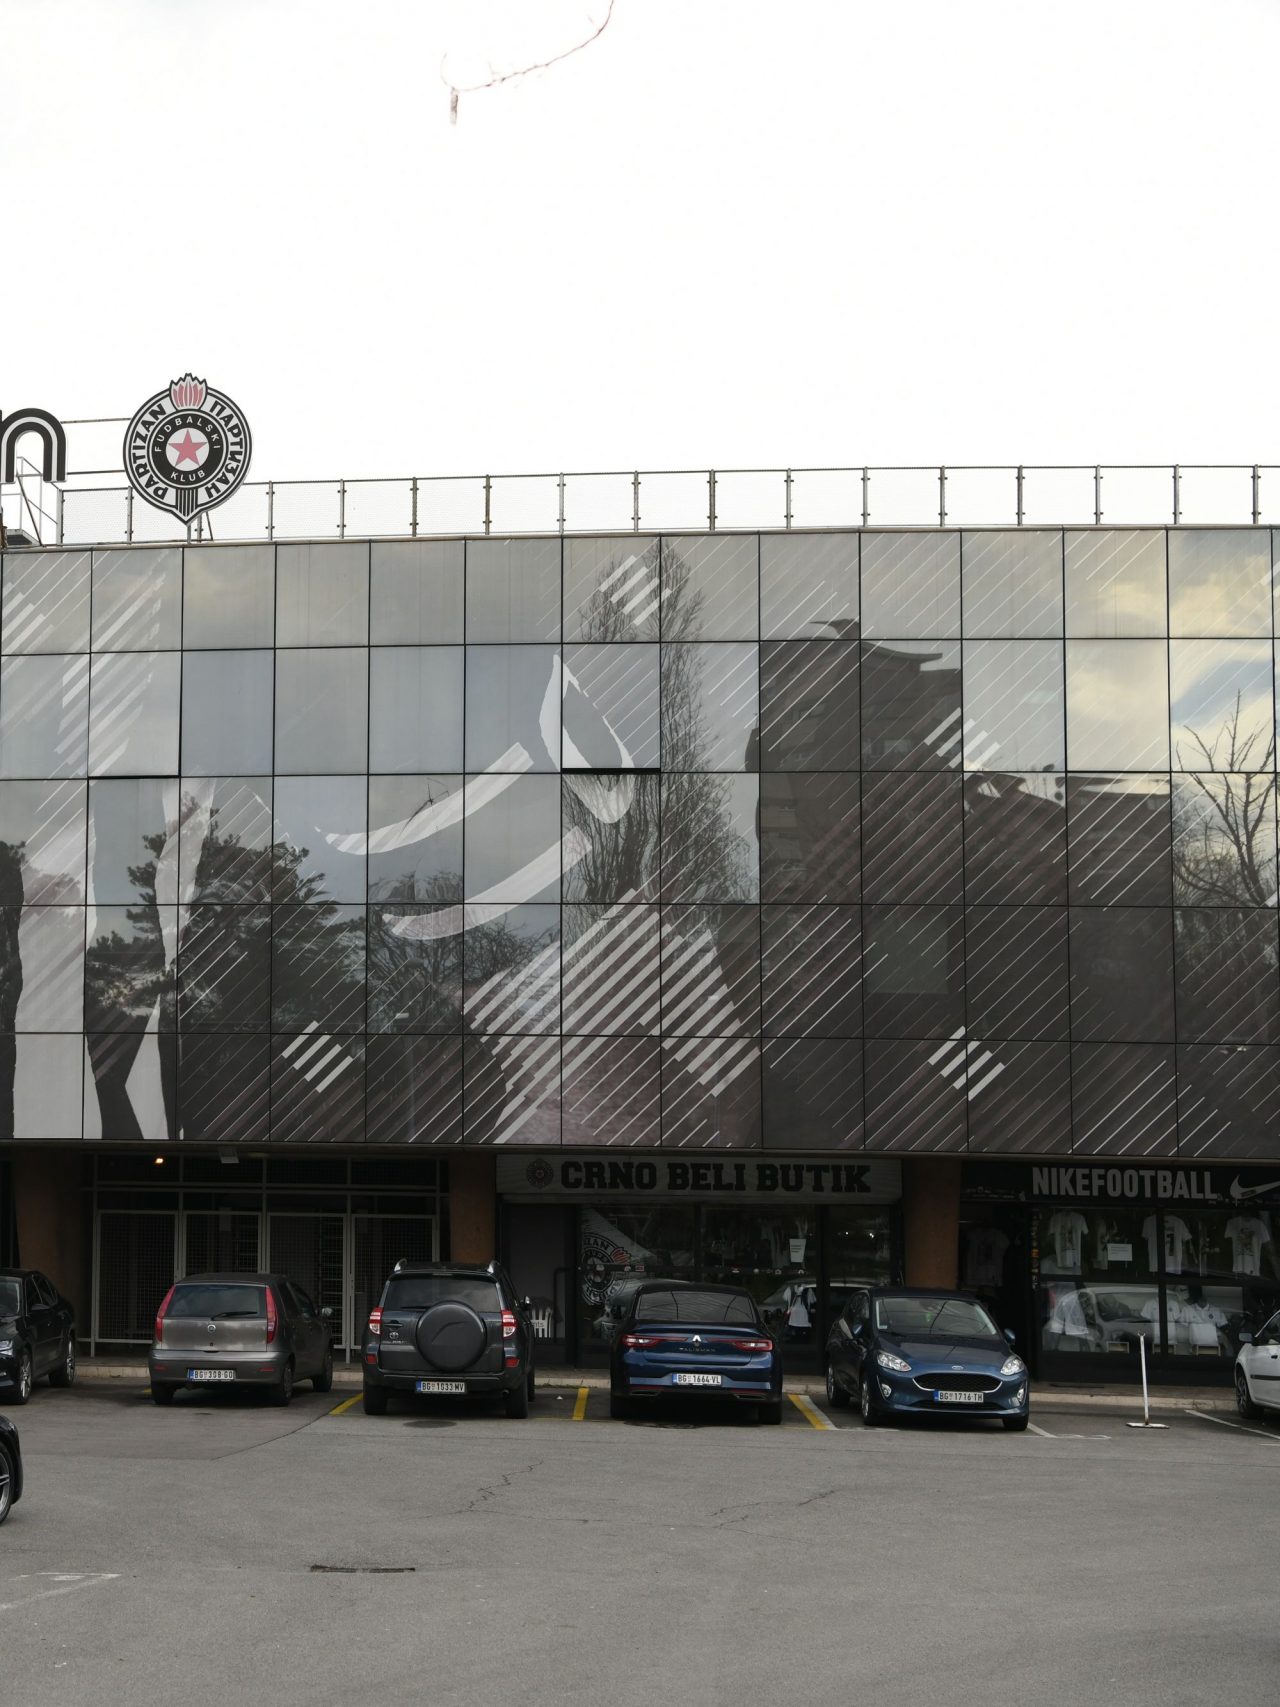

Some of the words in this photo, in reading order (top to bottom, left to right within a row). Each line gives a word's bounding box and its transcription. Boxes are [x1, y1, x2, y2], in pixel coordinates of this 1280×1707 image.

[155, 415, 220, 452] FUDBALSKI
[132, 403, 169, 501] PARTIZAN
[205, 400, 244, 499] ПАРТИЗАН
[170, 470, 206, 482] KLUB
[560, 1161, 657, 1191] CRNO
[667, 1162, 746, 1192] BELI
[756, 1163, 871, 1193] BUTIK
[1032, 1166, 1218, 1200] NIKEFOOTBALL
[194, 1371, 203, 1379] BG
[422, 1382, 431, 1390] BG
[677, 1374, 687, 1382] BG
[939, 1392, 949, 1400] BG
